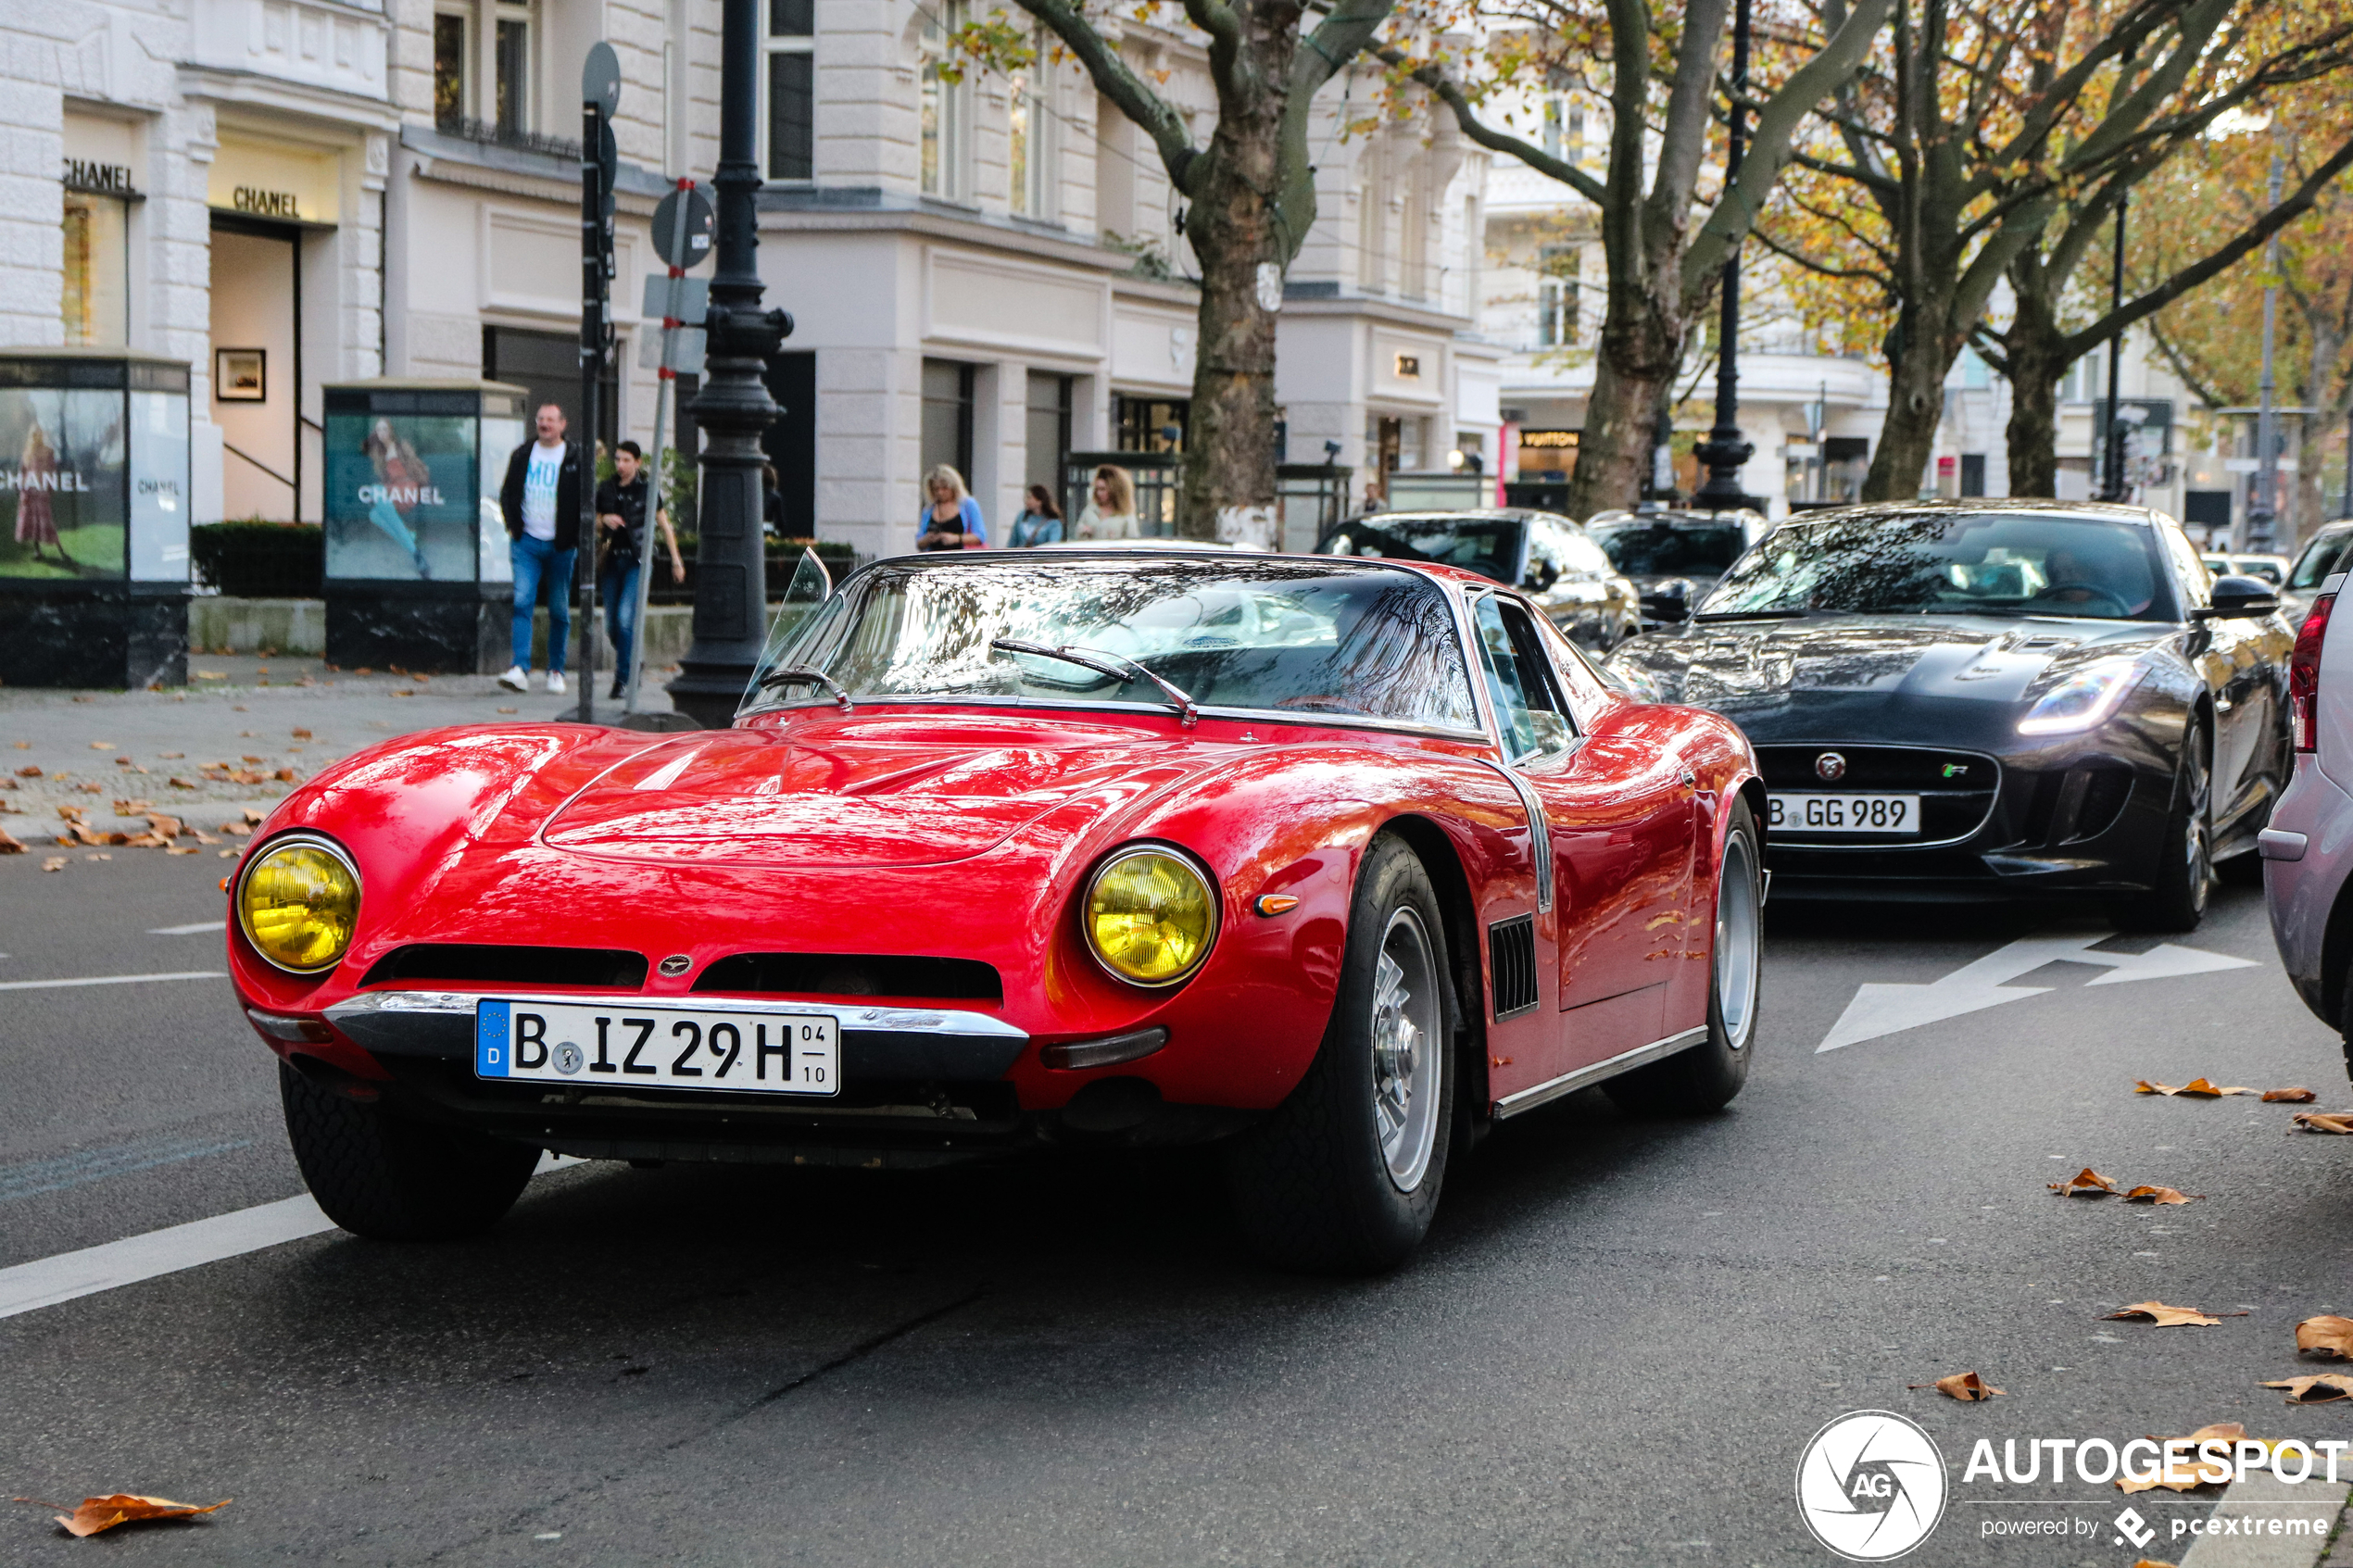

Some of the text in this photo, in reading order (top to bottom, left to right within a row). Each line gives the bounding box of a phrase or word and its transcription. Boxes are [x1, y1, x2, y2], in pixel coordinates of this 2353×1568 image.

[233, 186, 300, 219] CHANEL
[137, 478, 181, 496] CHANEL
[358, 484, 446, 506] CHANEL
[1768, 798, 1906, 827] B GG 989
[514, 1012, 548, 1070] B
[801, 1024, 825, 1042] 04
[487, 1047, 500, 1064] D
[803, 1067, 825, 1083] 10
